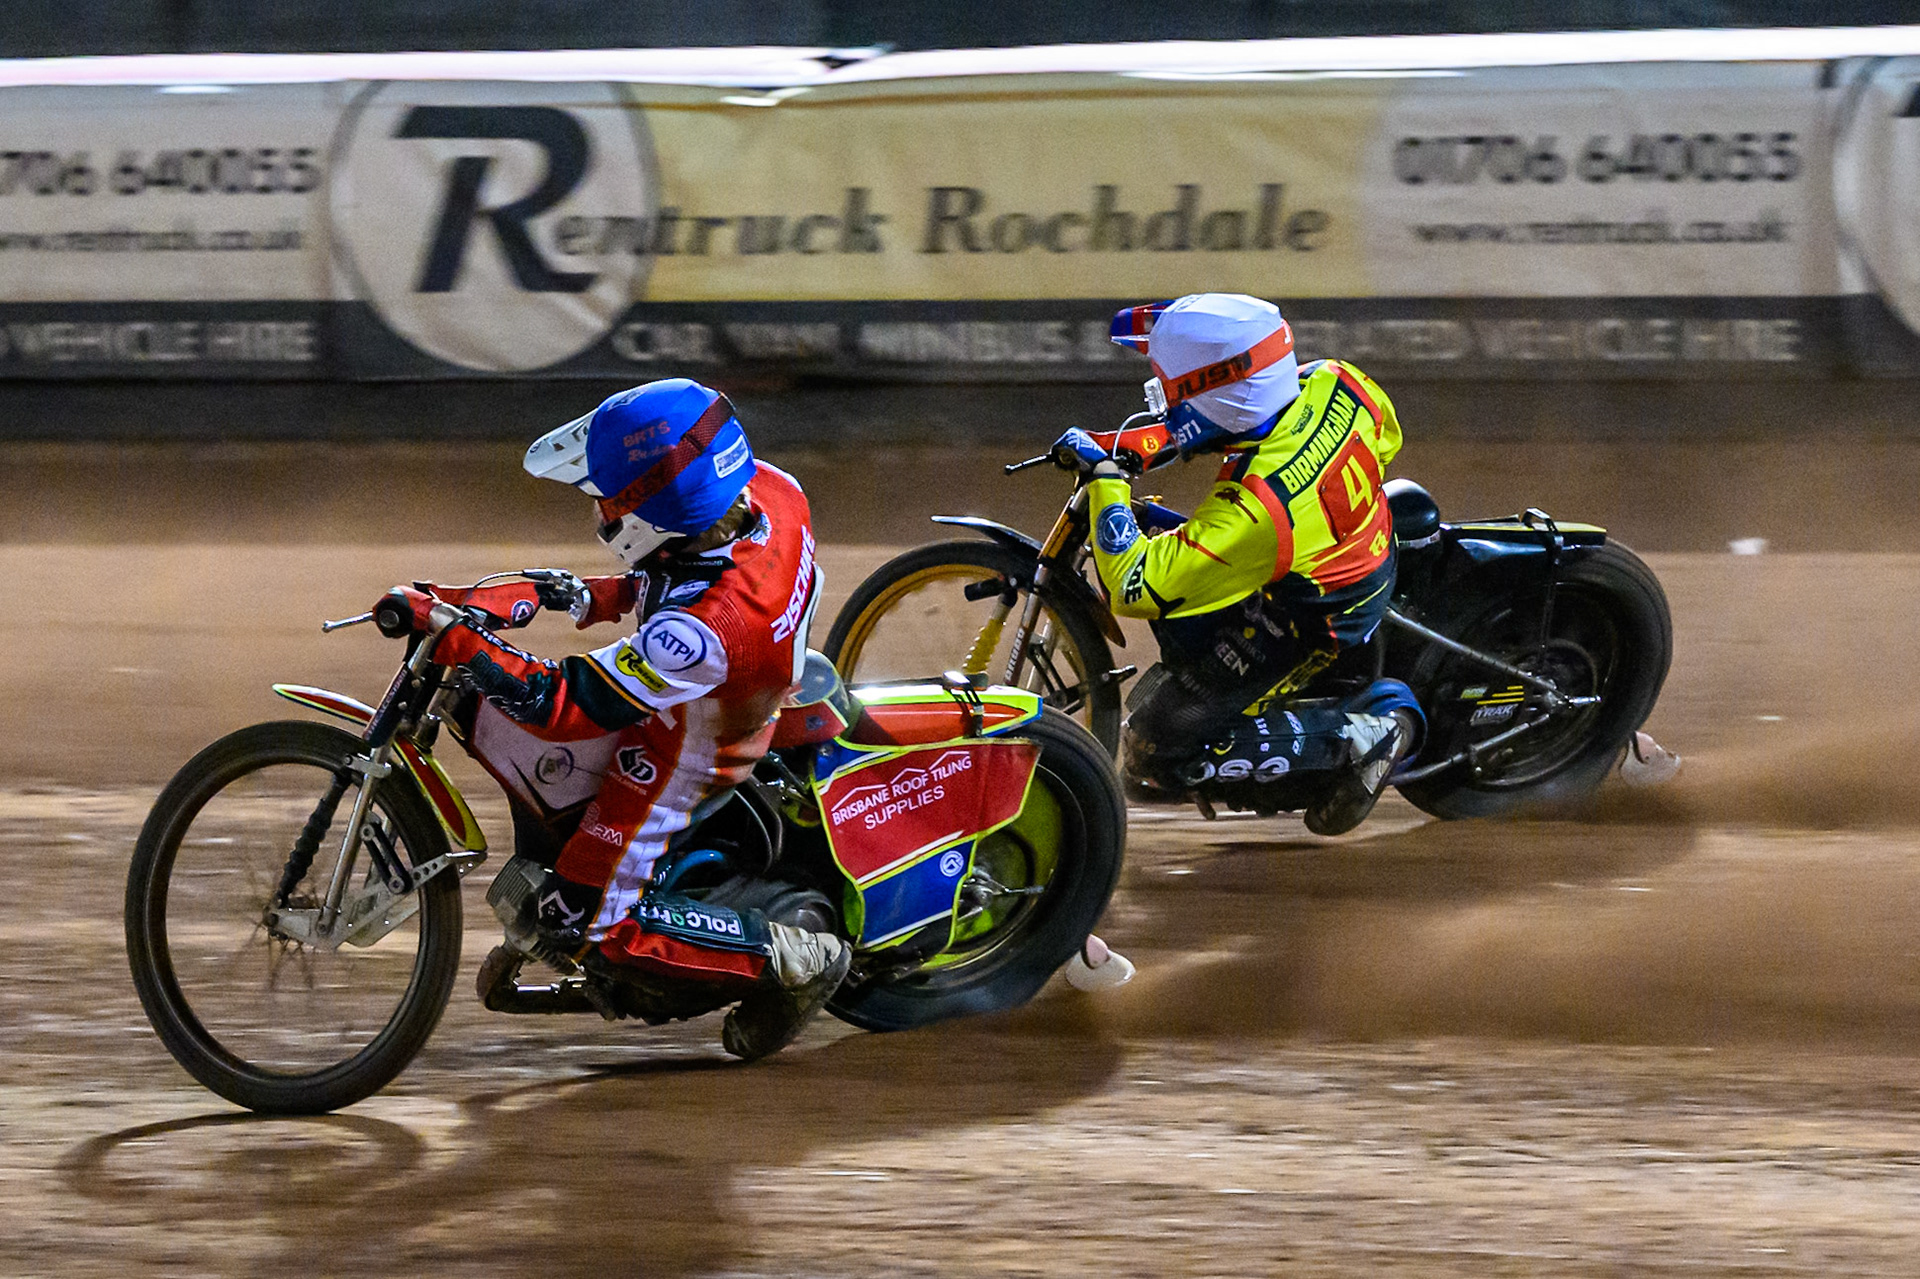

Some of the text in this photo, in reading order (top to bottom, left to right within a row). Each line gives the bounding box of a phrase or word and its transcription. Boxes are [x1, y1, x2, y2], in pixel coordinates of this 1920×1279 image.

[111, 147, 320, 195] 640055
[1576, 131, 1800, 184] 640055
[916, 184, 1332, 258] Rochdale
[1279, 389, 1357, 495] BIRMINGHAM
[1341, 455, 1373, 512] 4
[652, 629, 696, 662] ATPI
[831, 756, 973, 826] BRISBANE ROOF TILING
[864, 785, 946, 830] SUPPLIES
